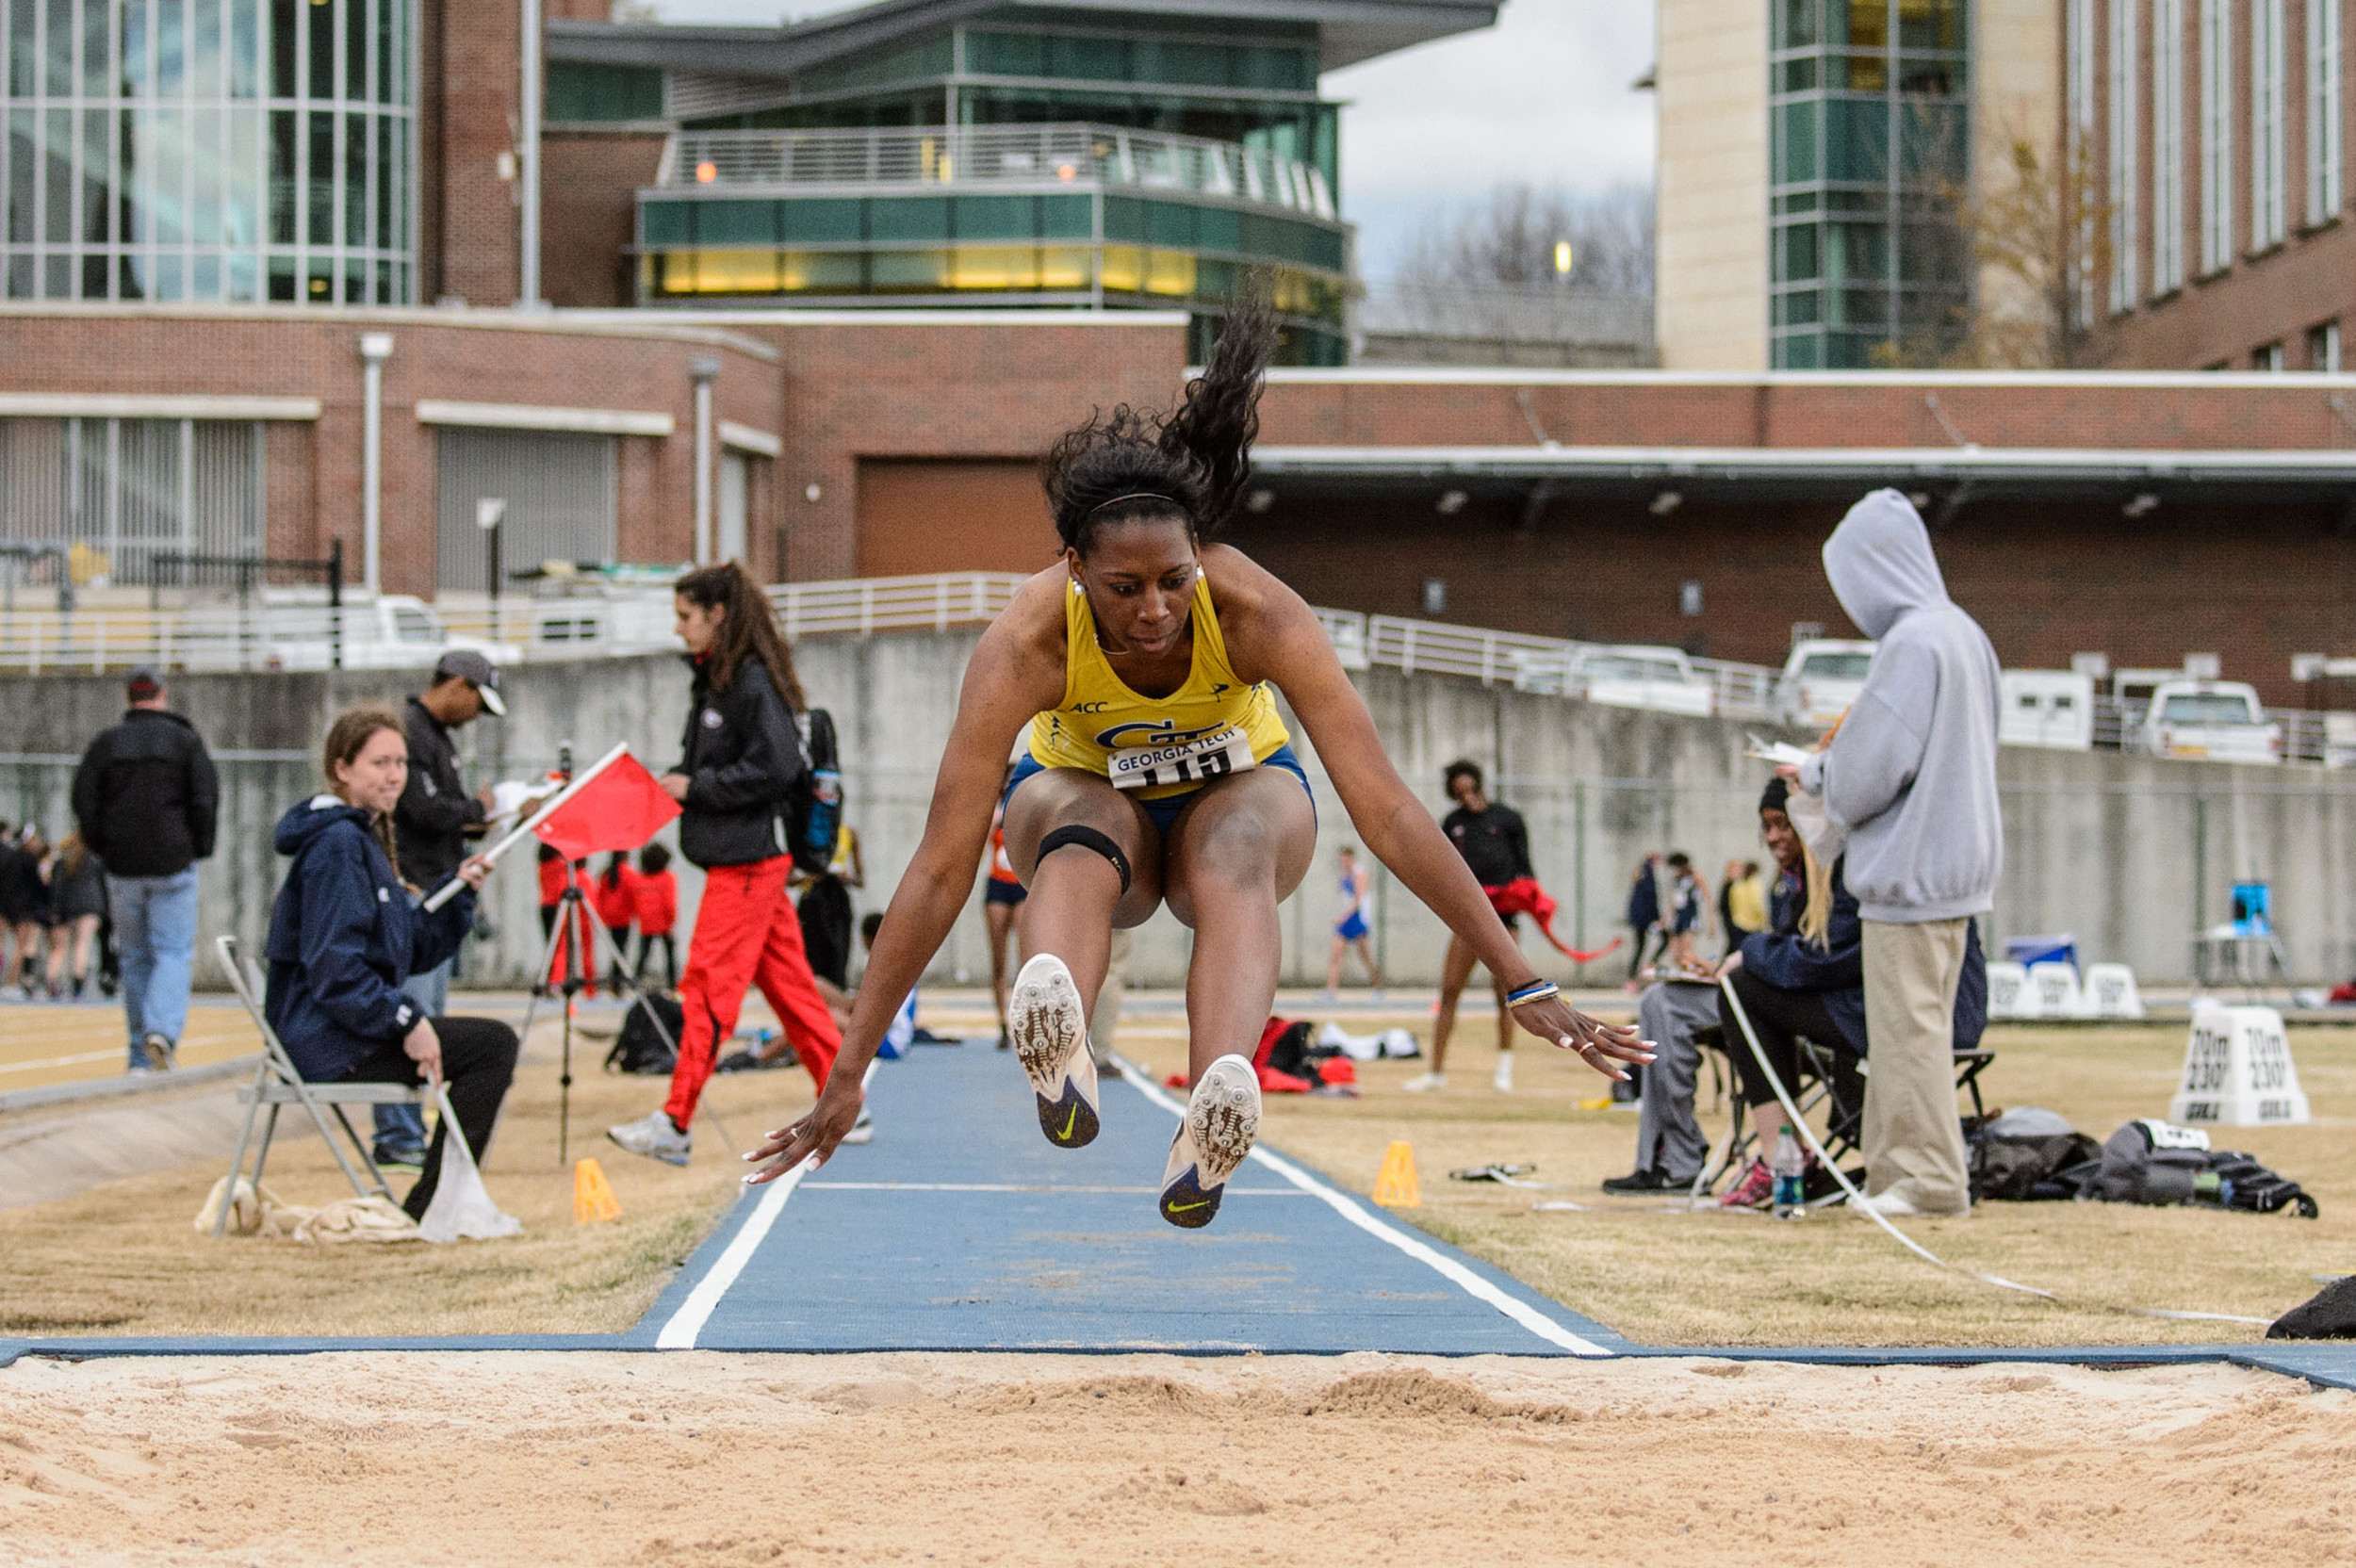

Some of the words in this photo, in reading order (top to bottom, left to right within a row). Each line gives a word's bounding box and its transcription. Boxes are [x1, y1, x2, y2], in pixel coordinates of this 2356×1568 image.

[1070, 701, 1108, 713] ACC
[1118, 745, 1193, 772] GEORGIA
[1198, 730, 1235, 750] TECH
